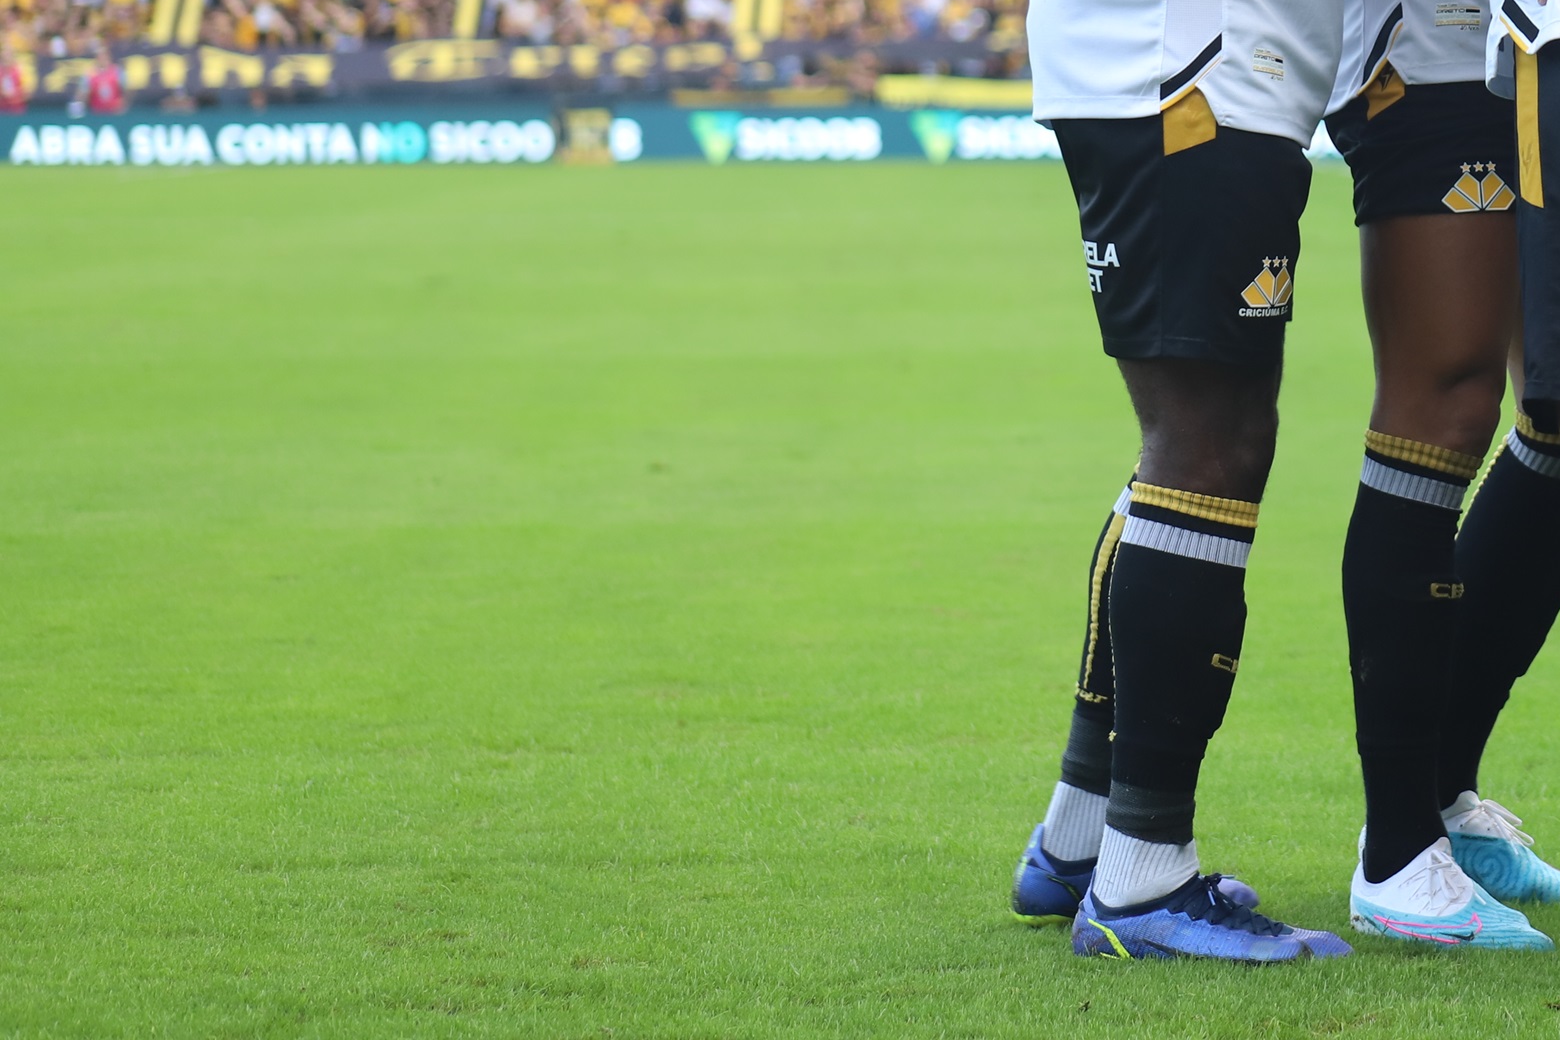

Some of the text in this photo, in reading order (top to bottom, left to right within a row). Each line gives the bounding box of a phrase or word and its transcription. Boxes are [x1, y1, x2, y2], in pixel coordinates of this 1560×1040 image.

[10, 123, 126, 165] ABRA
[129, 123, 215, 165] SUA
[215, 122, 359, 164] CONTA
[359, 121, 428, 164] NO
